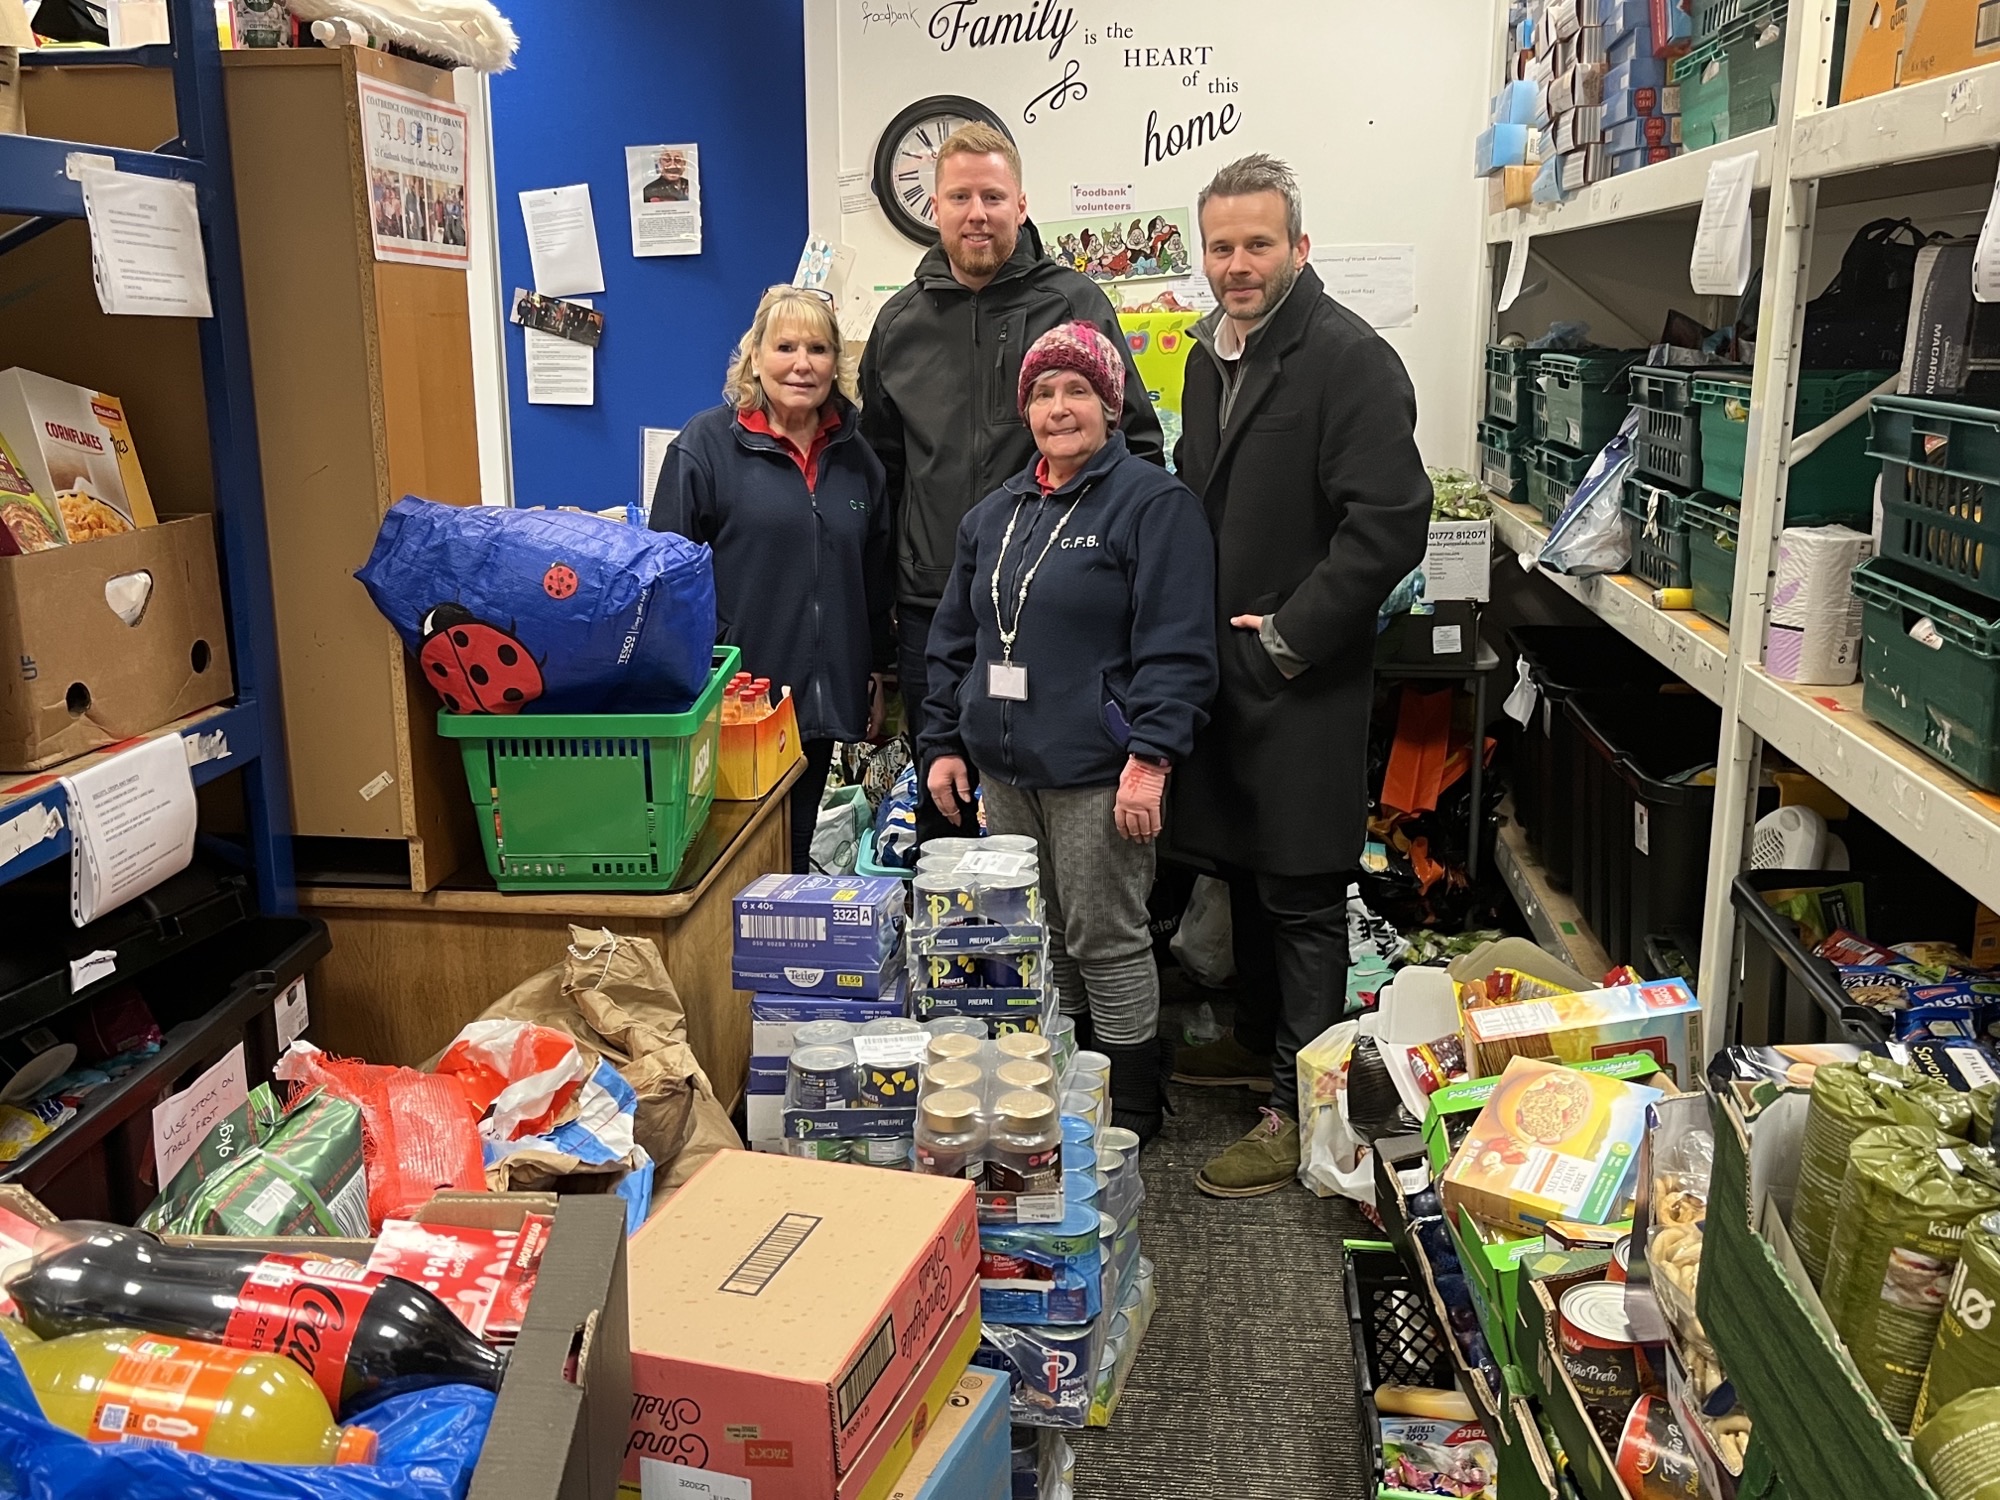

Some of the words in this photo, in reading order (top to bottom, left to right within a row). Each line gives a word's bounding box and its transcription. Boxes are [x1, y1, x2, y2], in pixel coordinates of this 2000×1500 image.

[861, 1, 921, 34] foodbank
[928, 0, 1078, 61] Family
[1084, 28, 1097, 45] is
[1106, 22, 1134, 39] the
[1123, 46, 1213, 67] HEART
[1182, 70, 1200, 87] of
[1208, 77, 1238, 94] this
[366, 95, 400, 114] COATBRIDGE
[401, 105, 433, 123] COMMUNITY
[433, 114, 463, 129] FOODBANK
[1144, 102, 1242, 168] home
[1076, 188, 1127, 197] Foodbank
[1075, 202, 1132, 211] volunteers
[1926, 323, 1942, 394] MACARON
[45, 422, 104, 451] CORNFLAKES
[1429, 532, 1454, 540] 01772
[1455, 531, 1486, 539] 812071
[617, 635, 636, 664] TESCO
[742, 902, 748, 910] 6
[757, 902, 774, 911] 40s
[833, 909, 858, 921] 3323
[861, 909, 870, 922] A
[969, 937, 995, 945] PINEAPPLE
[789, 969, 820, 983] Tetley
[940, 977, 965, 985] PRINCES
[968, 998, 993, 1006] PINEAPPLE
[163, 1113, 188, 1140] USE
[190, 1088, 218, 1118] STOCK
[222, 1072, 235, 1088] ON
[164, 1131, 192, 1161] TABLE
[1559, 1166, 1580, 1195] WHEAT
[516, 1222, 543, 1269] SHORTBREAD
[1053, 1241, 1073, 1253] 45p
[1586, 1365, 1617, 1382] Preto
[1608, 1385, 1633, 1397] Brine
[1408, 1425, 1436, 1433] STRIPE
[1406, 1433, 1429, 1441] COOL
[749, 1446, 789, 1460] JACK'S
